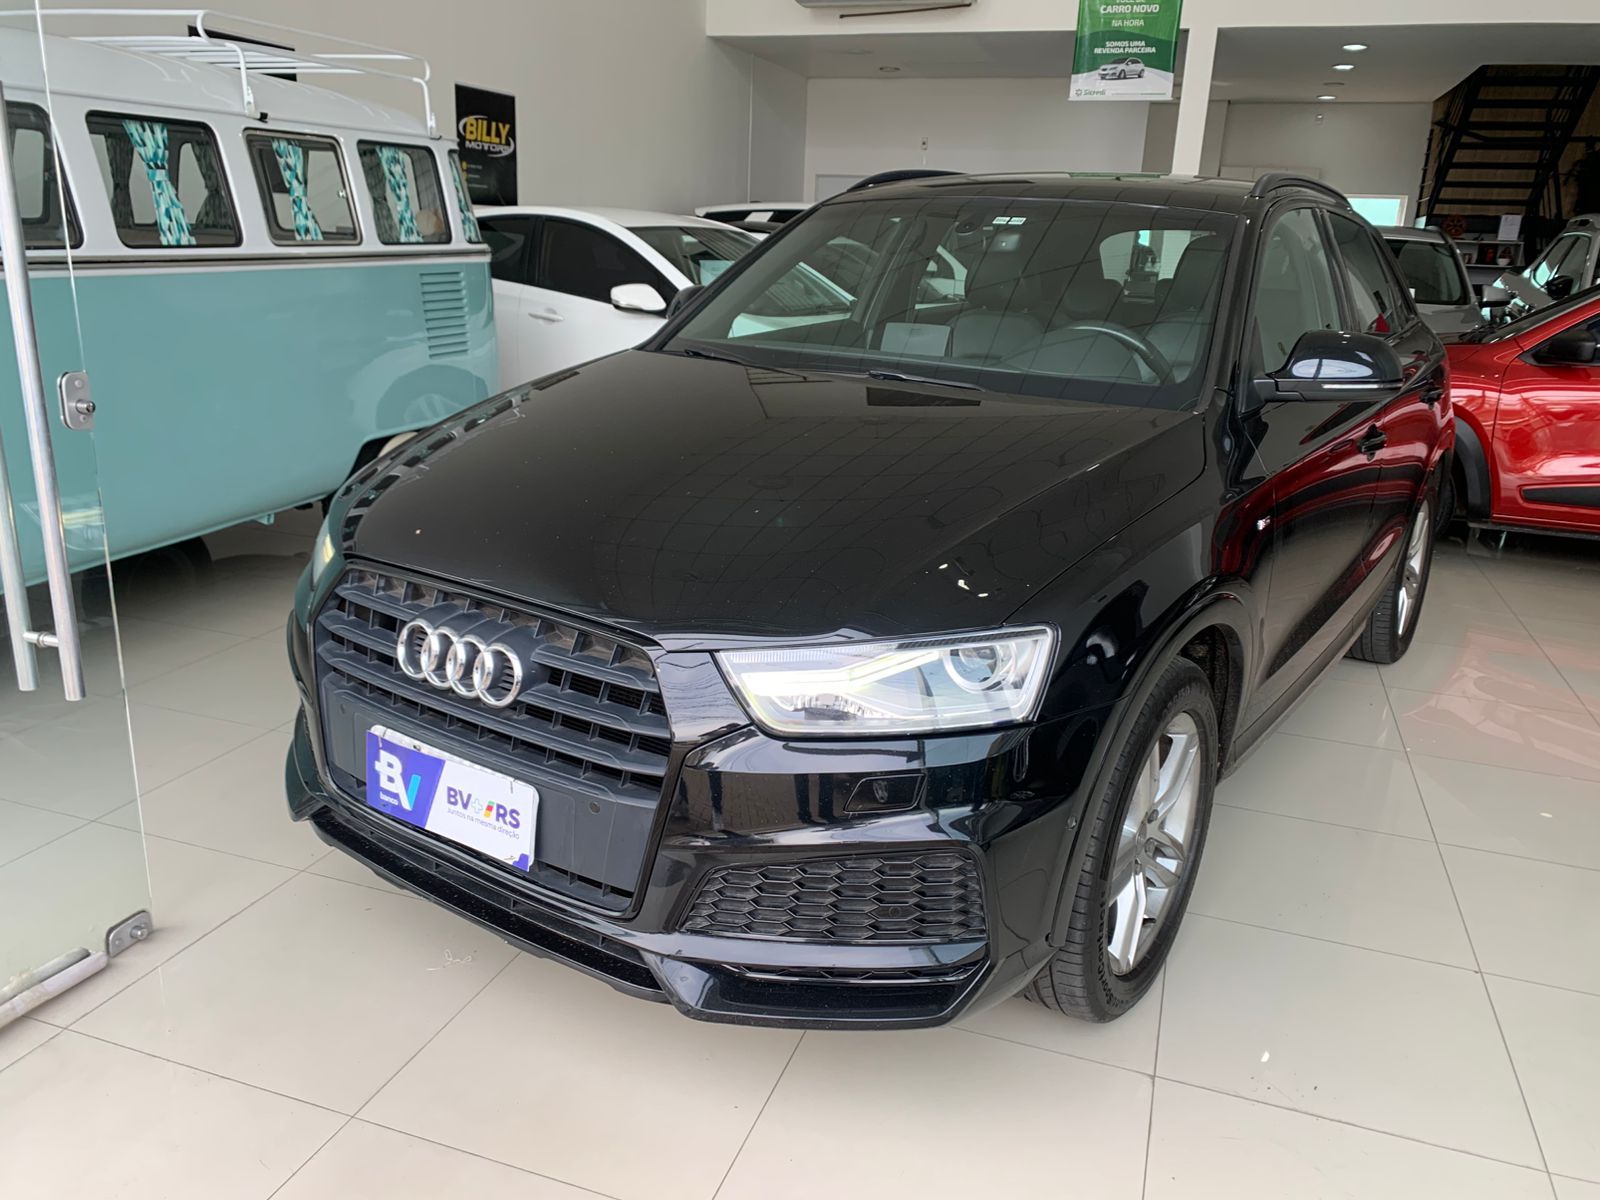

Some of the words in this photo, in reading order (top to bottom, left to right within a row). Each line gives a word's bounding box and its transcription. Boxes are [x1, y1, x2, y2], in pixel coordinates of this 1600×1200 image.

[1100, 5, 1131, 13] CARRO
[1123, 19, 1145, 27] HORA
[465, 118, 510, 145] BILLY
